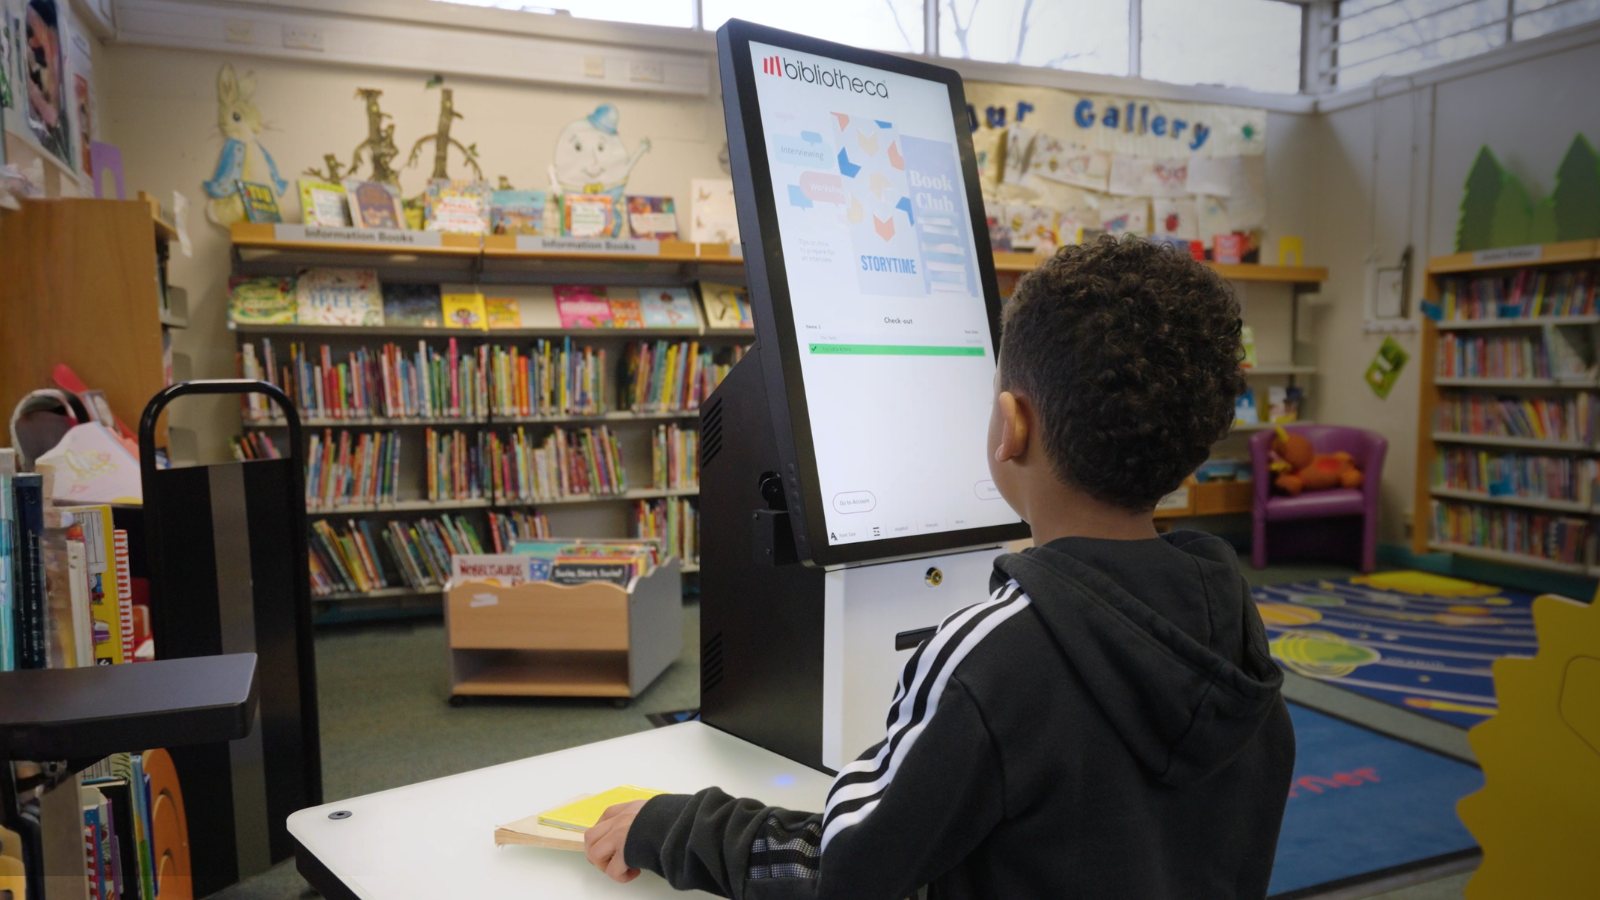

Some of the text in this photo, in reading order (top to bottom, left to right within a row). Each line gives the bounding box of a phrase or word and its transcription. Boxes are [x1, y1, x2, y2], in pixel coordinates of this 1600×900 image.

[783, 57, 889, 99] bibliotheca
[1075, 99, 1211, 150] Gallery
[780, 146, 824, 161] Interviewing
[910, 170, 954, 192] Book
[915, 193, 955, 212] Club
[304, 228, 414, 243] Information Books
[541, 239, 636, 251] Information Books
[860, 255, 917, 274] STORYTIME
[883, 316, 913, 326] Check-out
